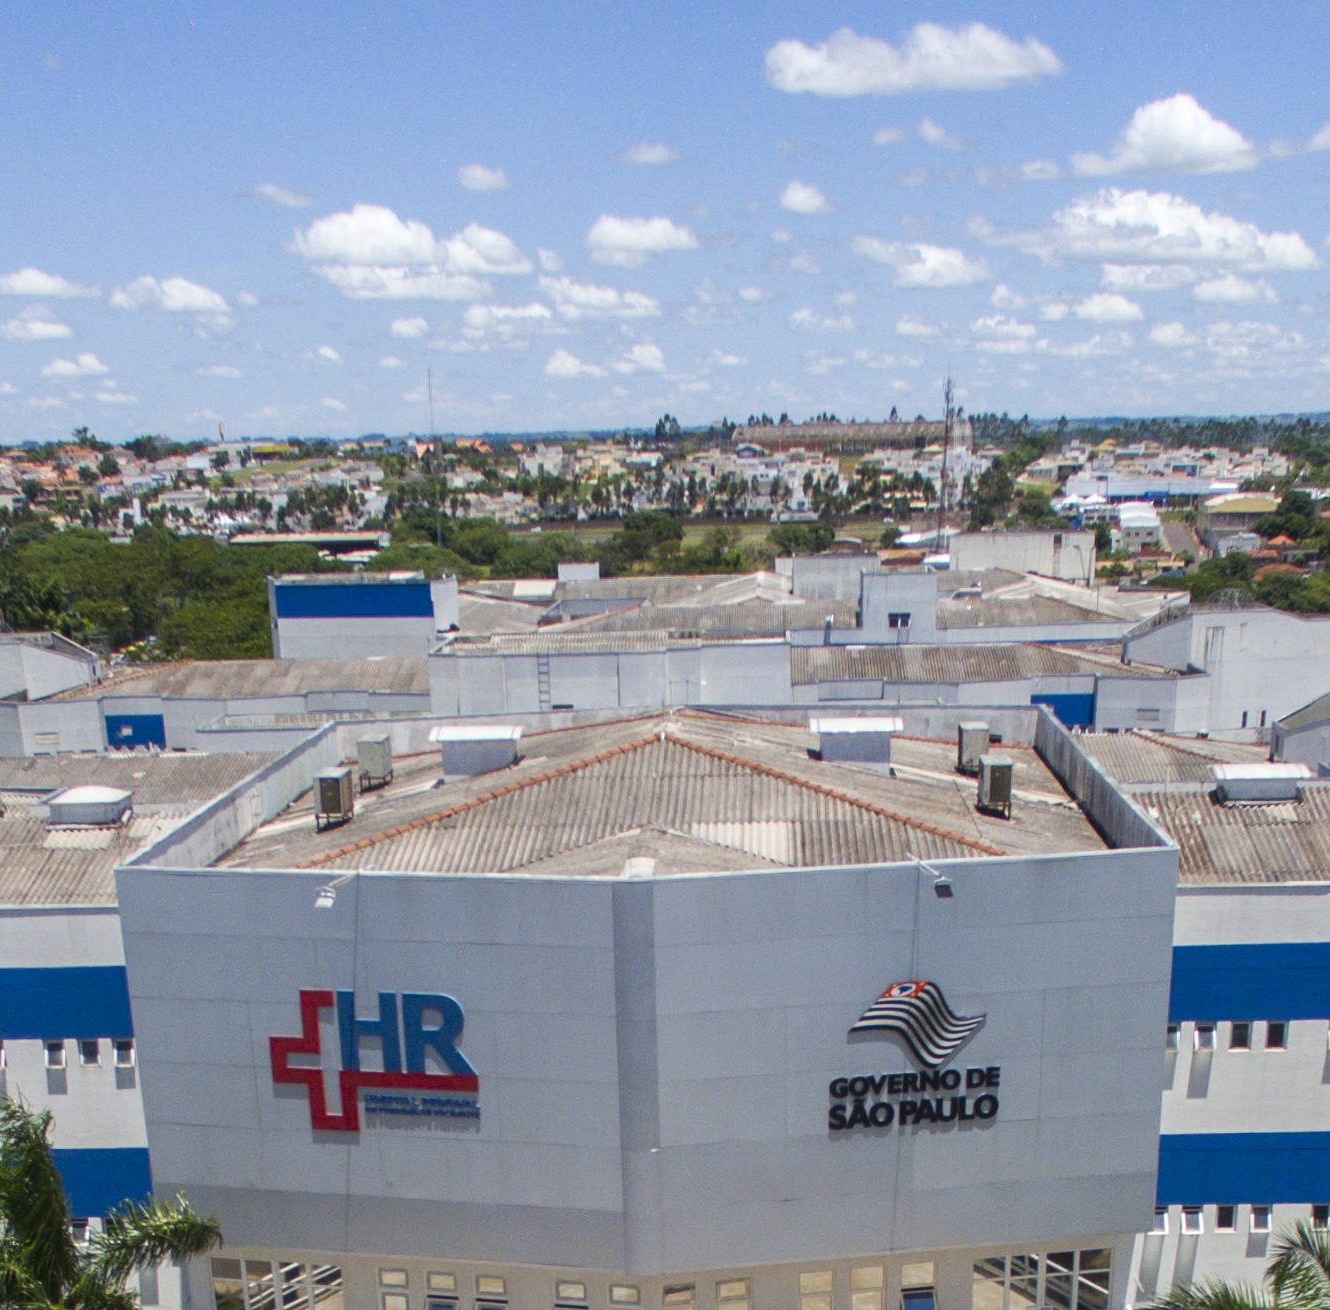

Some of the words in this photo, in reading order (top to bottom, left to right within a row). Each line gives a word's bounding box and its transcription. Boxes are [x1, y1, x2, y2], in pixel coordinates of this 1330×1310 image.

[336, 989, 479, 1076] HR
[829, 1069, 961, 1098] GOVERNO
[966, 1066, 1001, 1089] DE
[828, 1097, 894, 1130] SÃO
[899, 1094, 999, 1126] PAULO
